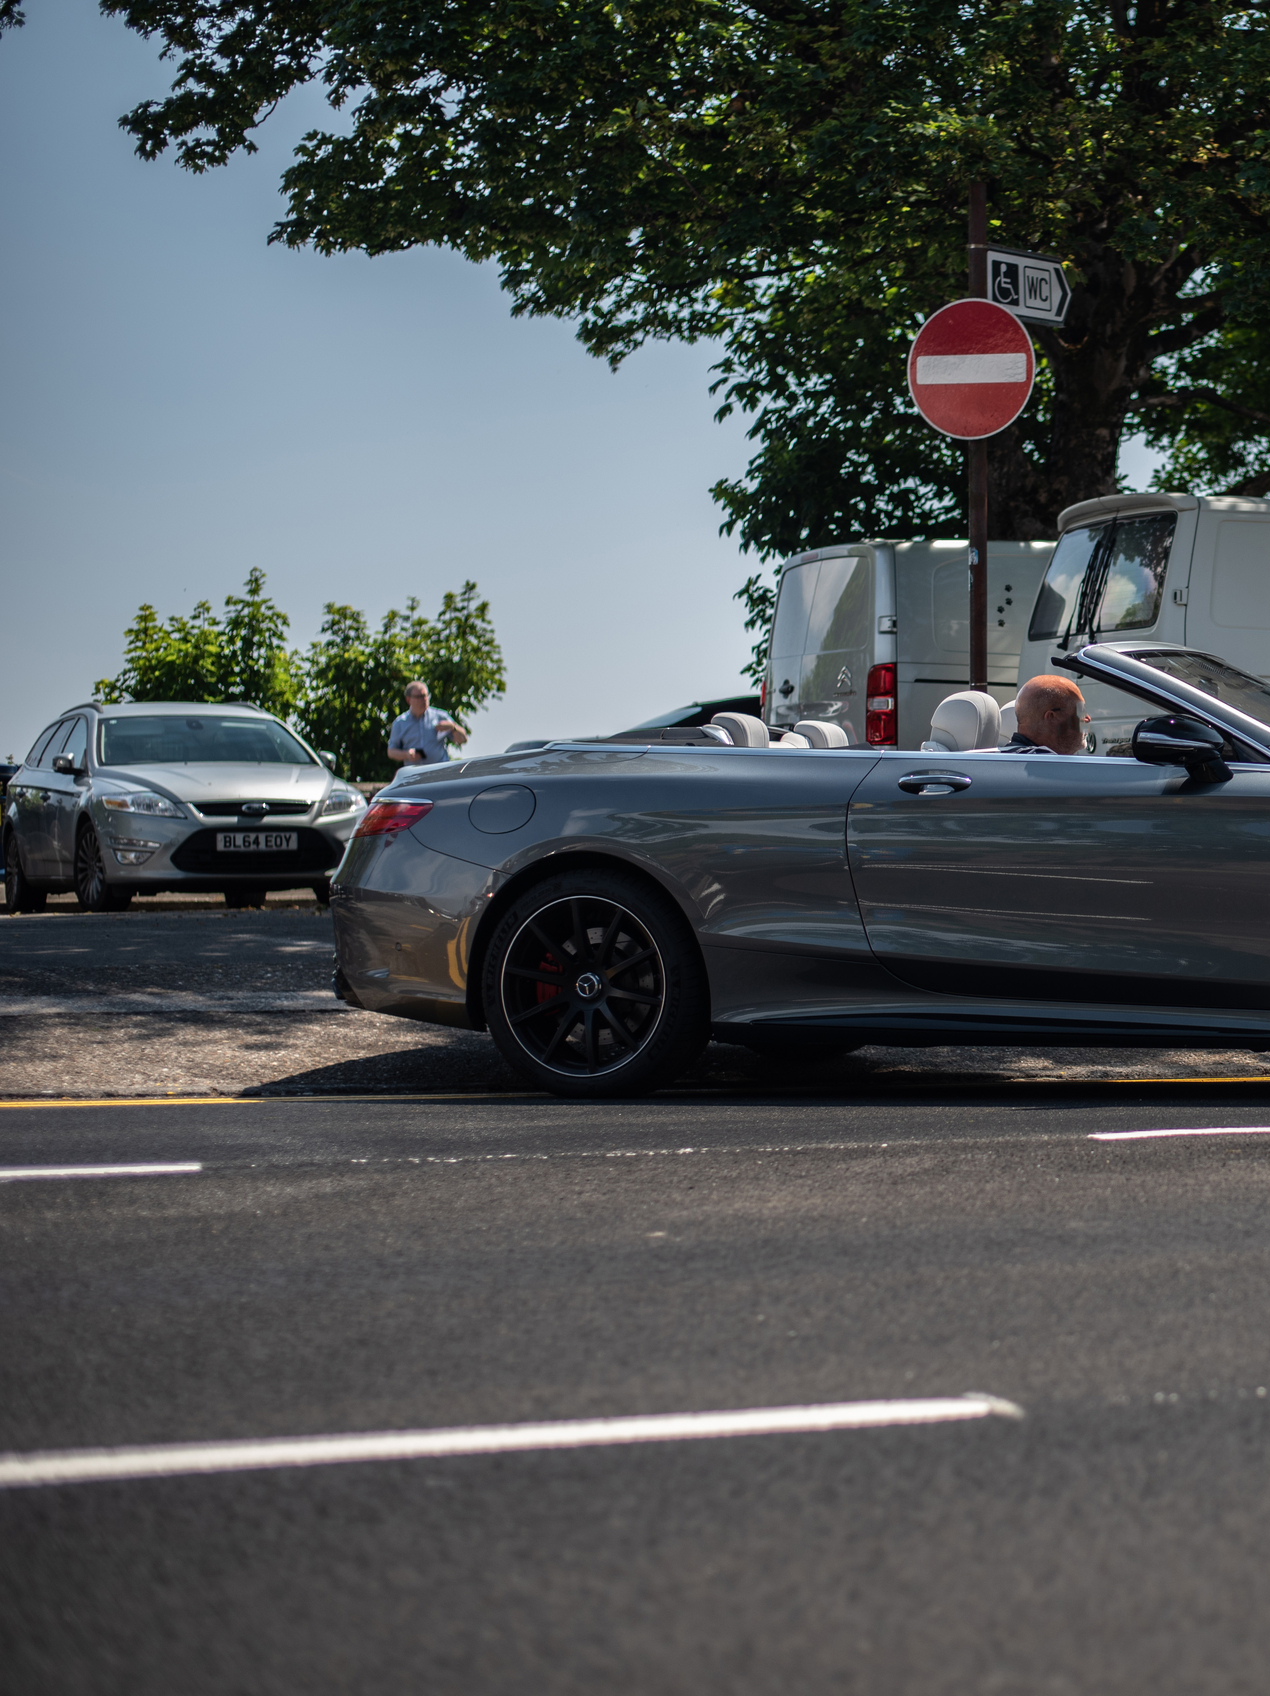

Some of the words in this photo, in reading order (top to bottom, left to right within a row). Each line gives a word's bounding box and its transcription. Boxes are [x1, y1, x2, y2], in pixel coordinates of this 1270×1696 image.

[1026, 275, 1049, 302] WC
[223, 834, 260, 849] BL64
[265, 834, 292, 848] EOY
[487, 912, 517, 985] MICHELIN
